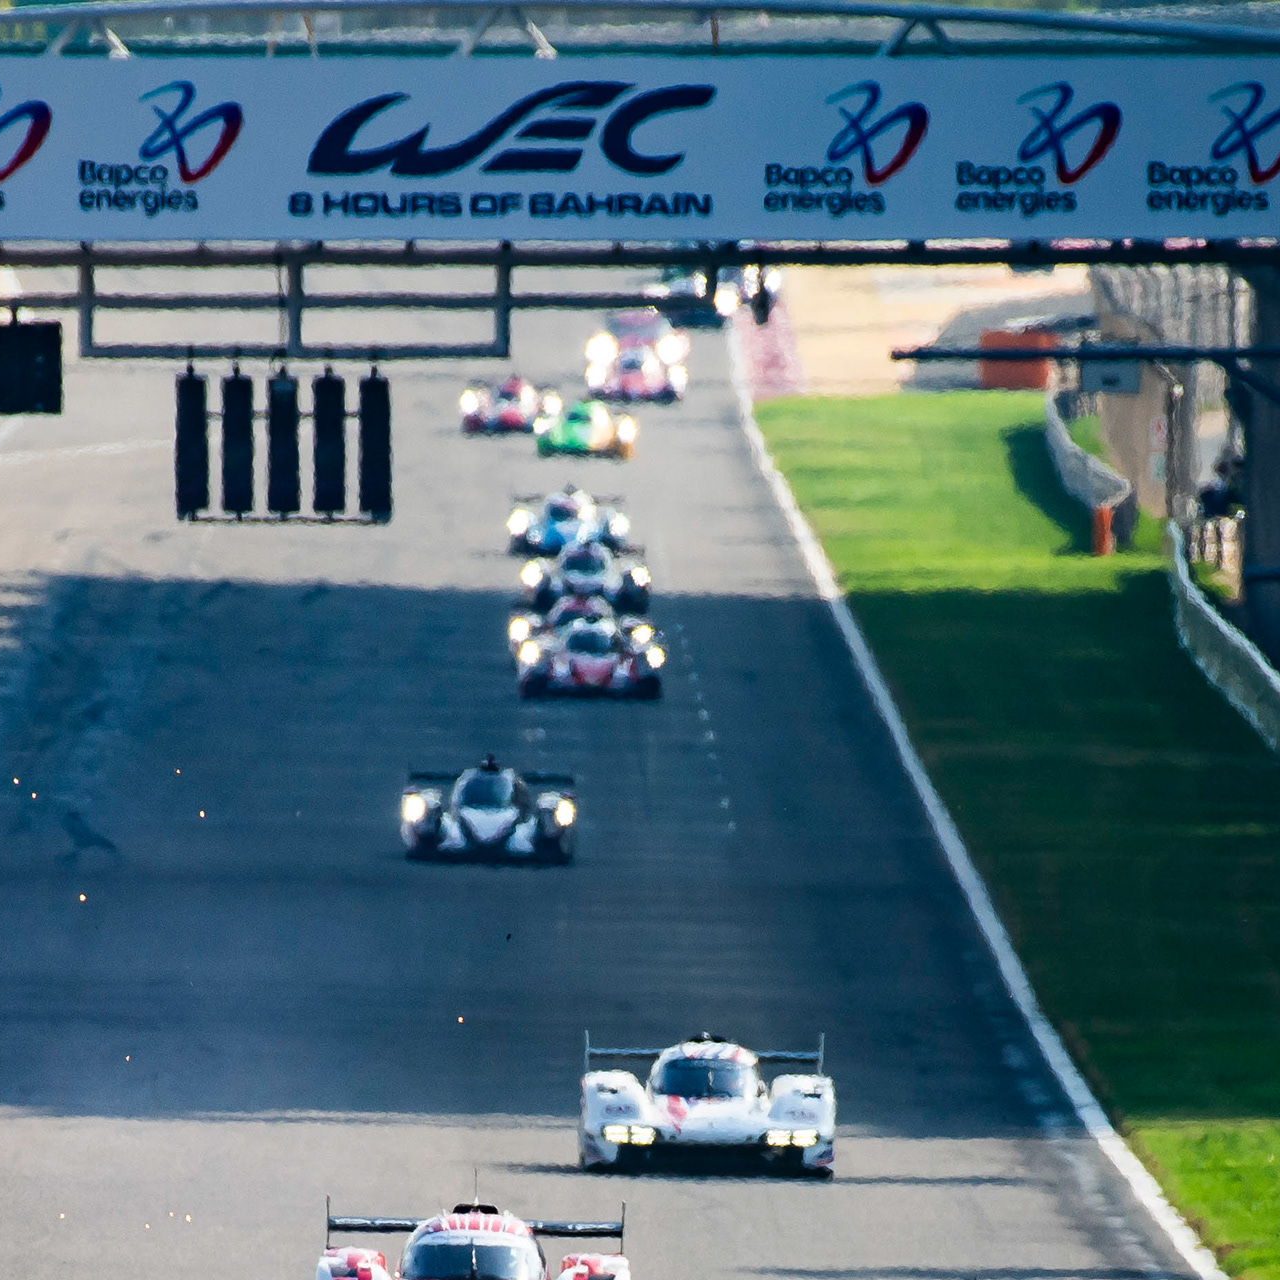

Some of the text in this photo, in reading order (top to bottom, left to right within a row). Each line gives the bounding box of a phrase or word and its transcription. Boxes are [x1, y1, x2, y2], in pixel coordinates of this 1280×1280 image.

[307, 80, 717, 178] WEC
[79, 160, 169, 190] Bapco
[765, 163, 853, 191] Bapco
[955, 161, 1045, 190] Bapco
[1147, 161, 1238, 188] Bapco
[79, 186, 199, 217] energies
[289, 192, 713, 217] 8 HOURS OF BAHRAIN
[764, 187, 886, 217] energies
[955, 187, 1078, 217] energies
[1147, 187, 1269, 216] energies
